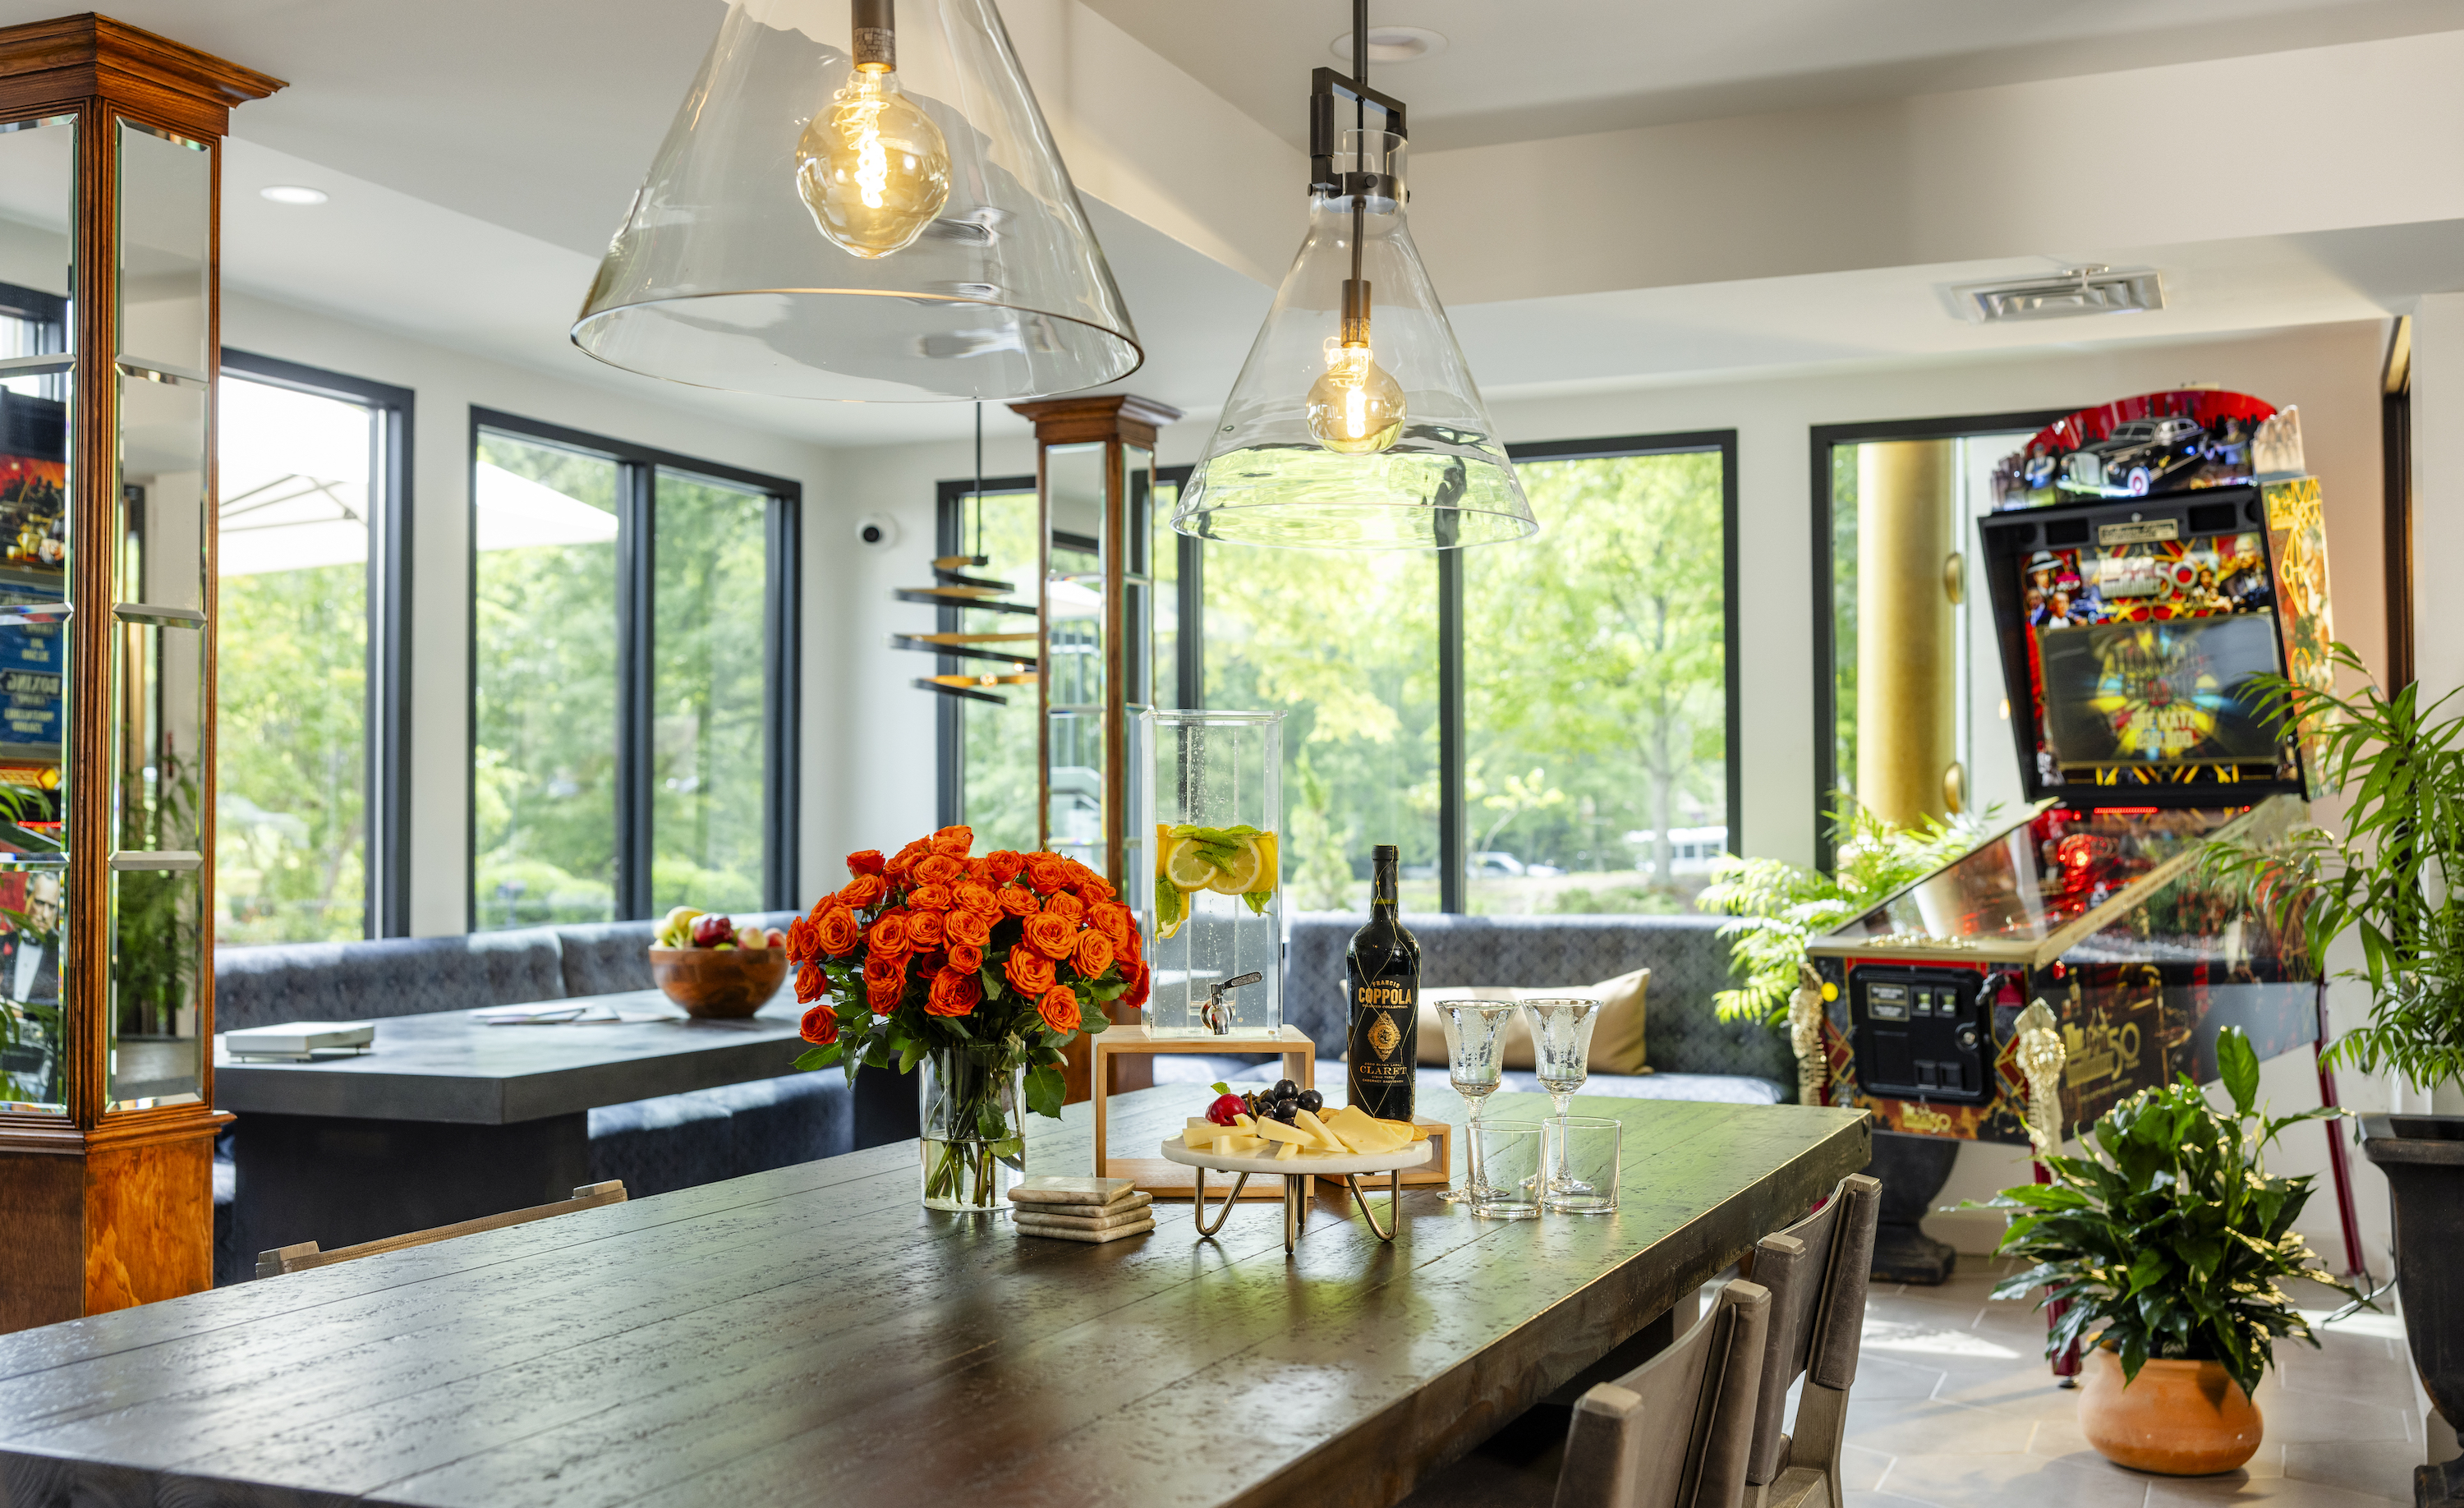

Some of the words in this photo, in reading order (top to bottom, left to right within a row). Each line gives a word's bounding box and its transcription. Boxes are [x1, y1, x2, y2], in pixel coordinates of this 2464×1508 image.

[2158, 710, 2196, 729] KATZ
[1372, 980, 1400, 988] FRANCIS
[1358, 986, 1412, 1005] COPPOLA
[2107, 1021, 2141, 1082] 50
[1359, 1064, 1408, 1075] CLARET
